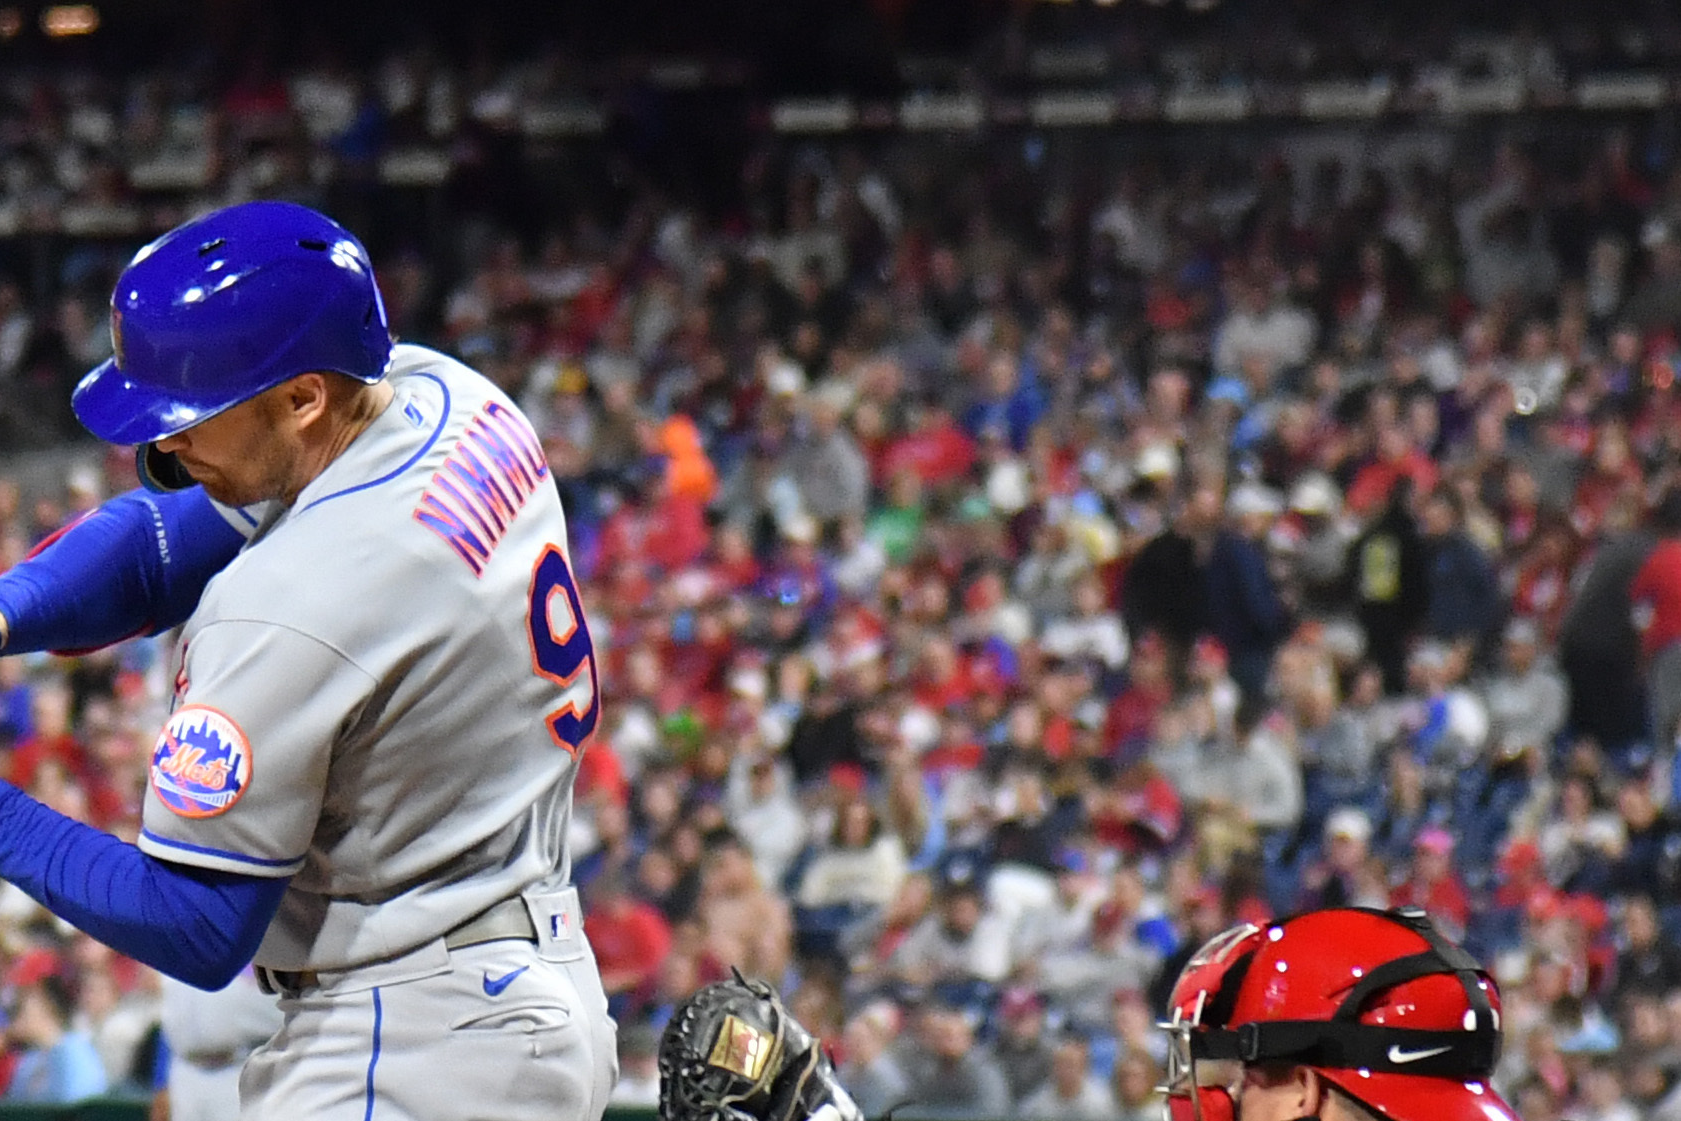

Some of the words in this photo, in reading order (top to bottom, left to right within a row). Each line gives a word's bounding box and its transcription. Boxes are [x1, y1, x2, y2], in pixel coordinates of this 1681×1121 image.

[413, 401, 548, 579] NIMMO
[525, 542, 602, 761] 9
[159, 742, 232, 791] Mets
